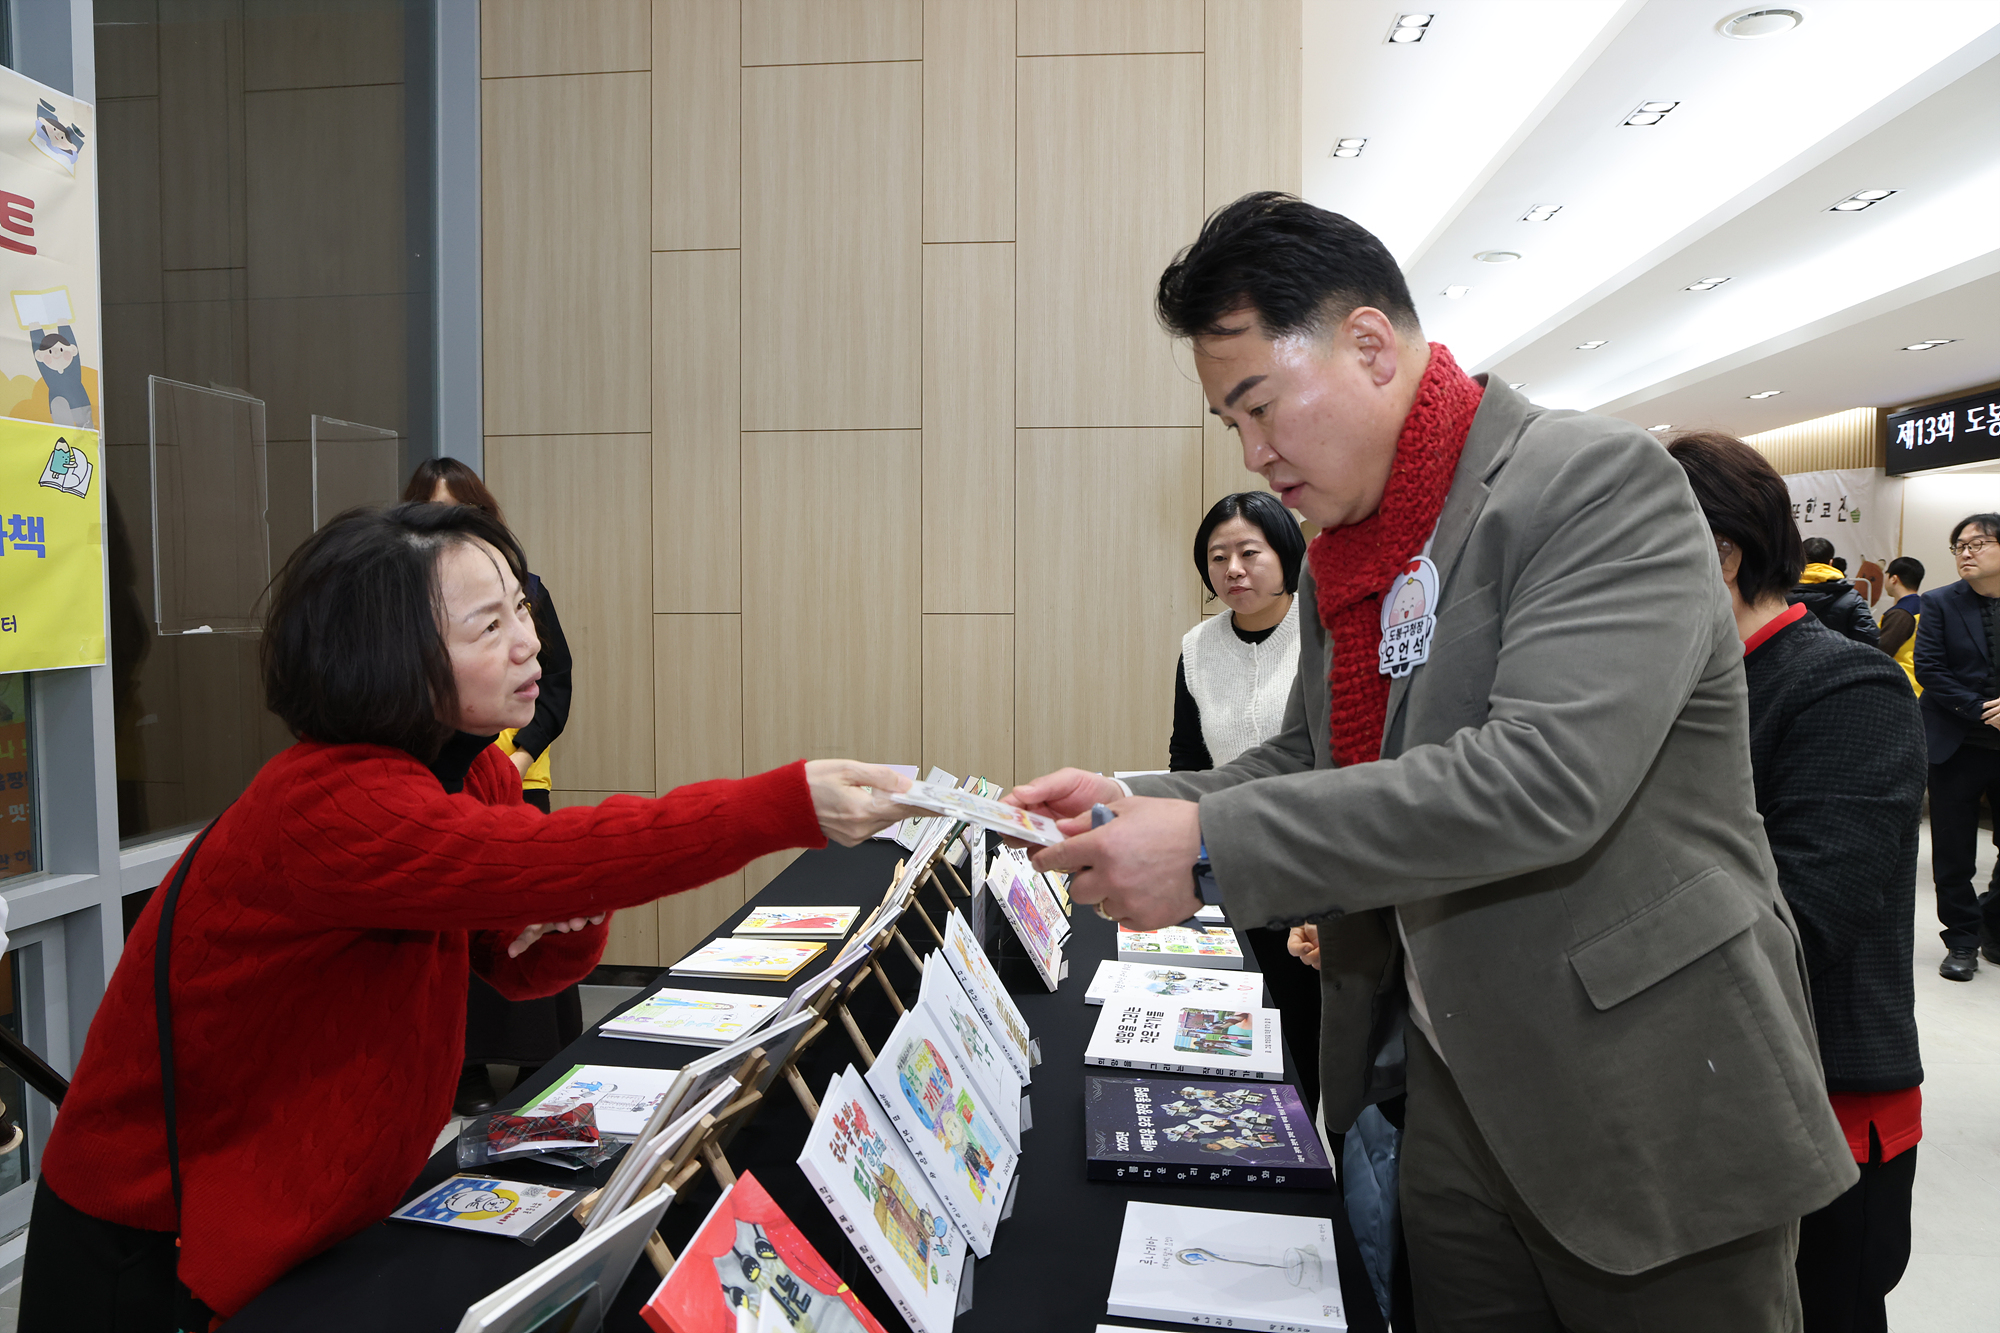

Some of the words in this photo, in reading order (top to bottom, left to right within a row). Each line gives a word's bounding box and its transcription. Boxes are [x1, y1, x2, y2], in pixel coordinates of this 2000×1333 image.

[1896, 410, 1955, 450] 제13회
[1389, 621, 1424, 642] 도봉구청장
[1384, 634, 1424, 664] 오언석
[1121, 1007, 1141, 1023] 그리는
[1144, 1011, 1164, 1028] 작가들
[1115, 1024, 1137, 1043] 희망을
[1140, 1031, 1160, 1043] 작은
[1098, 1058, 1132, 1067] 희망을
[1151, 1063, 1184, 1072] 그리는
[1203, 1067, 1224, 1075] 작은
[1230, 1069, 1263, 1078] 작가들
[1134, 1087, 1151, 1102] 동화집
[1136, 1103, 1153, 1114] 창작
[1138, 1116, 1154, 1127] 우리
[1115, 1132, 1129, 1151] 2025년
[1139, 1129, 1158, 1151] 아름다운
[1118, 1166, 1166, 1177] 아름다운
[1178, 1167, 1198, 1179] 우리
[1210, 1168, 1232, 1180] 창작
[1248, 1170, 1285, 1183] 동화집
[819, 1186, 834, 1204] 학교
[1192, 1316, 1233, 1326] 루나리아
